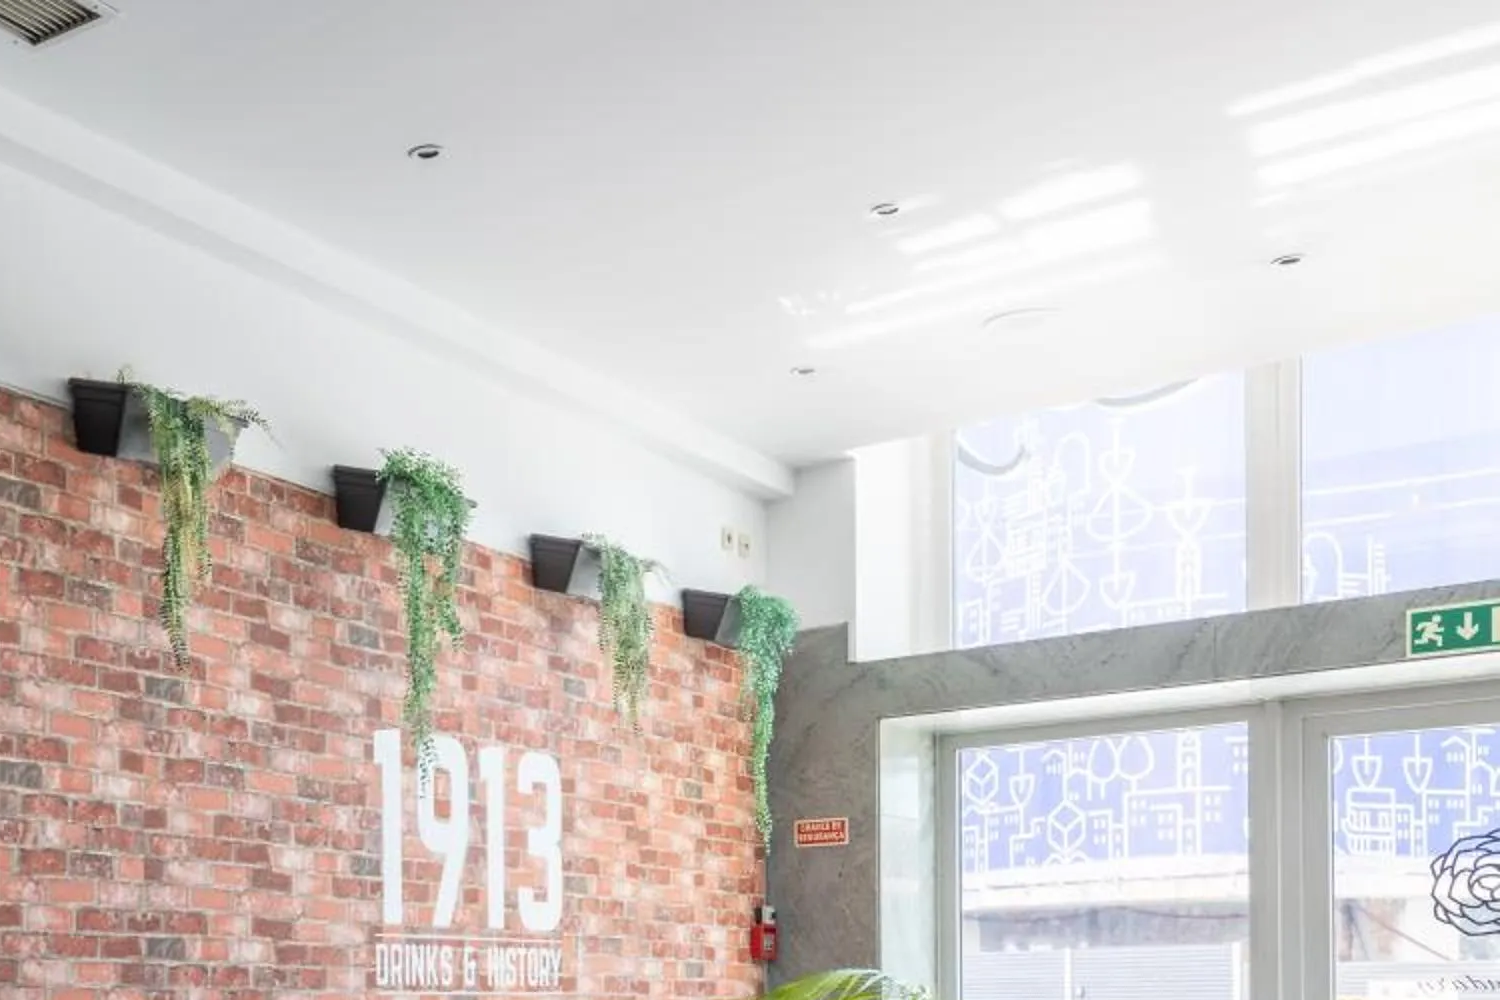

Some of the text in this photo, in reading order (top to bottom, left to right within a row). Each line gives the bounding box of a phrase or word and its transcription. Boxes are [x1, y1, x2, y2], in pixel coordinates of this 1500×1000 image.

[372, 728, 563, 931] 1913
[375, 942, 563, 988] DRINKS & HISTORY
